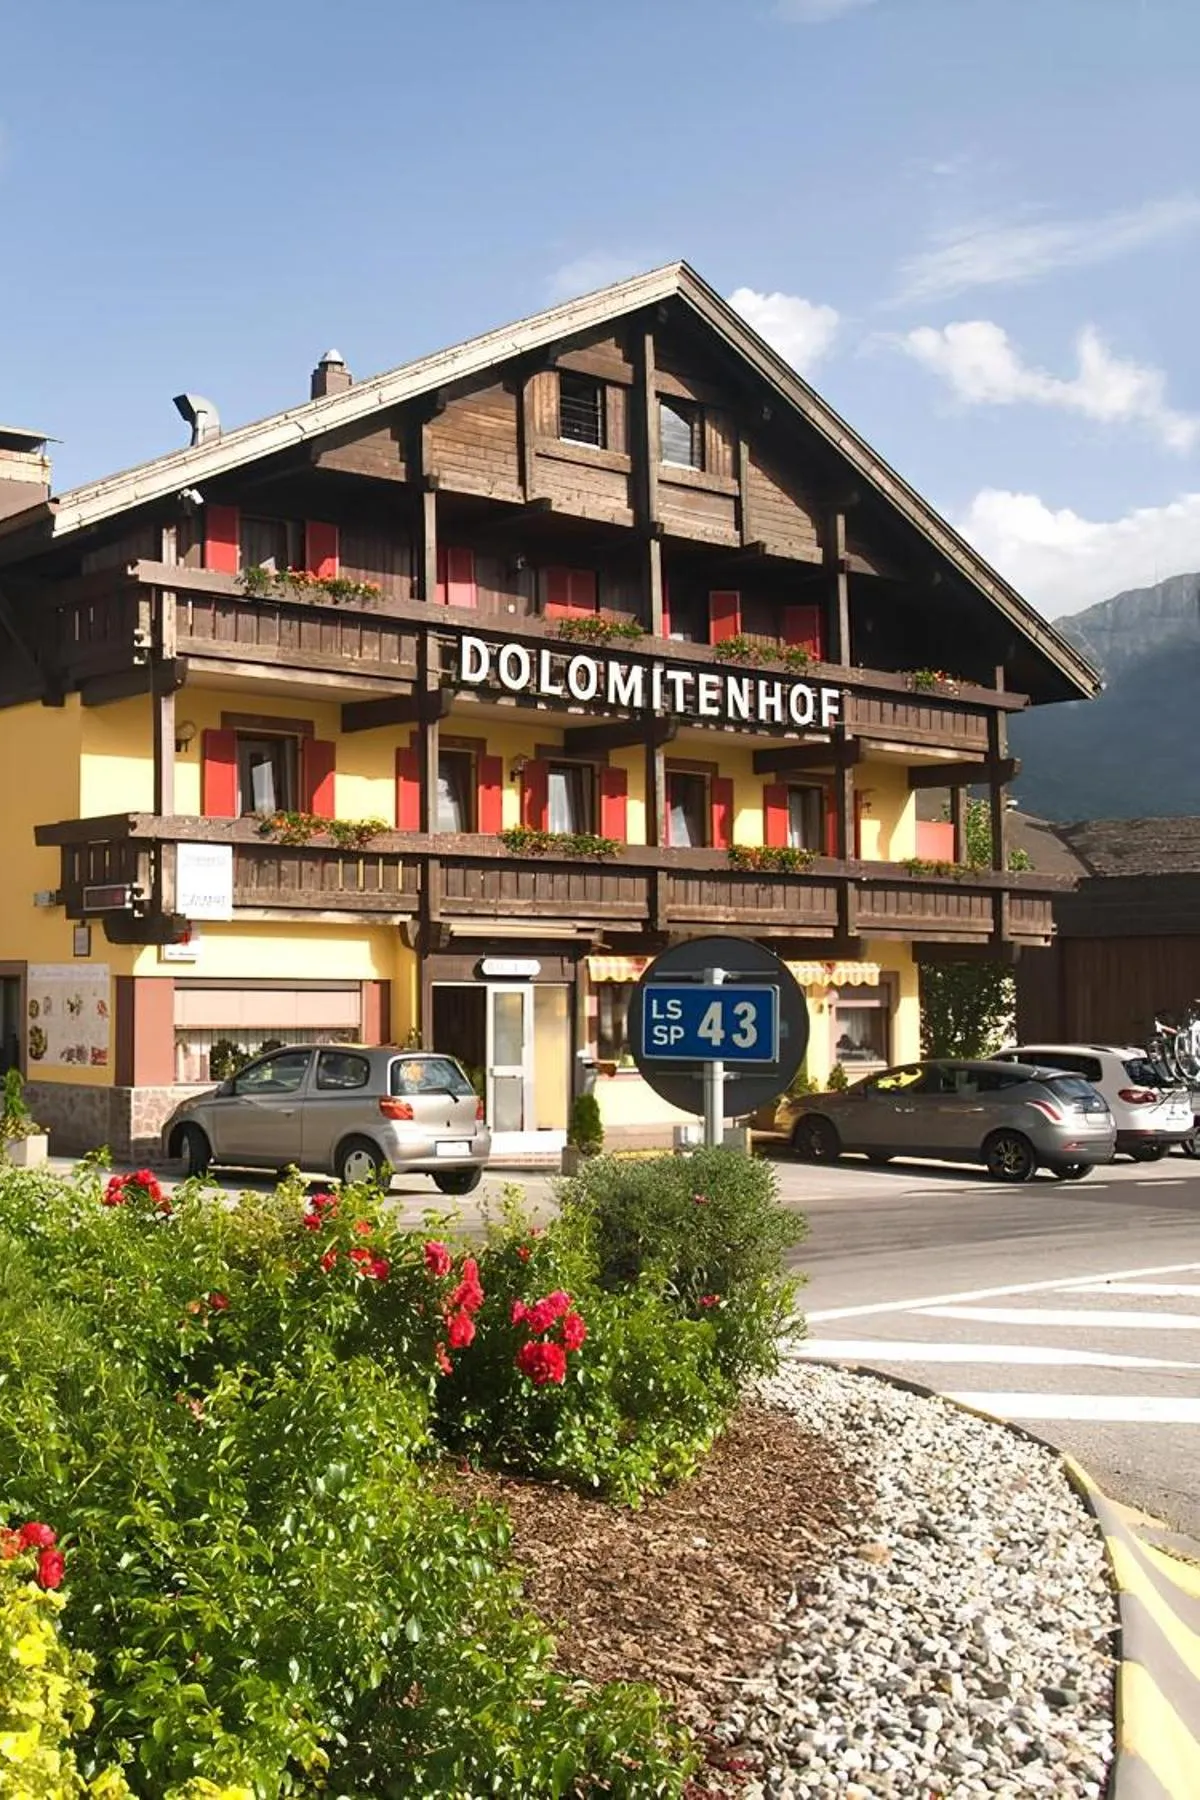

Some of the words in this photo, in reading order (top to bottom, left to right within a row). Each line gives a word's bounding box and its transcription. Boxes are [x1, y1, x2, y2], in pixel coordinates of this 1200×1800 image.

[460, 635, 841, 727] DOLOMITENHOF
[651, 999, 683, 1020] LS
[697, 1001, 758, 1049] 43
[652, 1025, 685, 1046] SP
